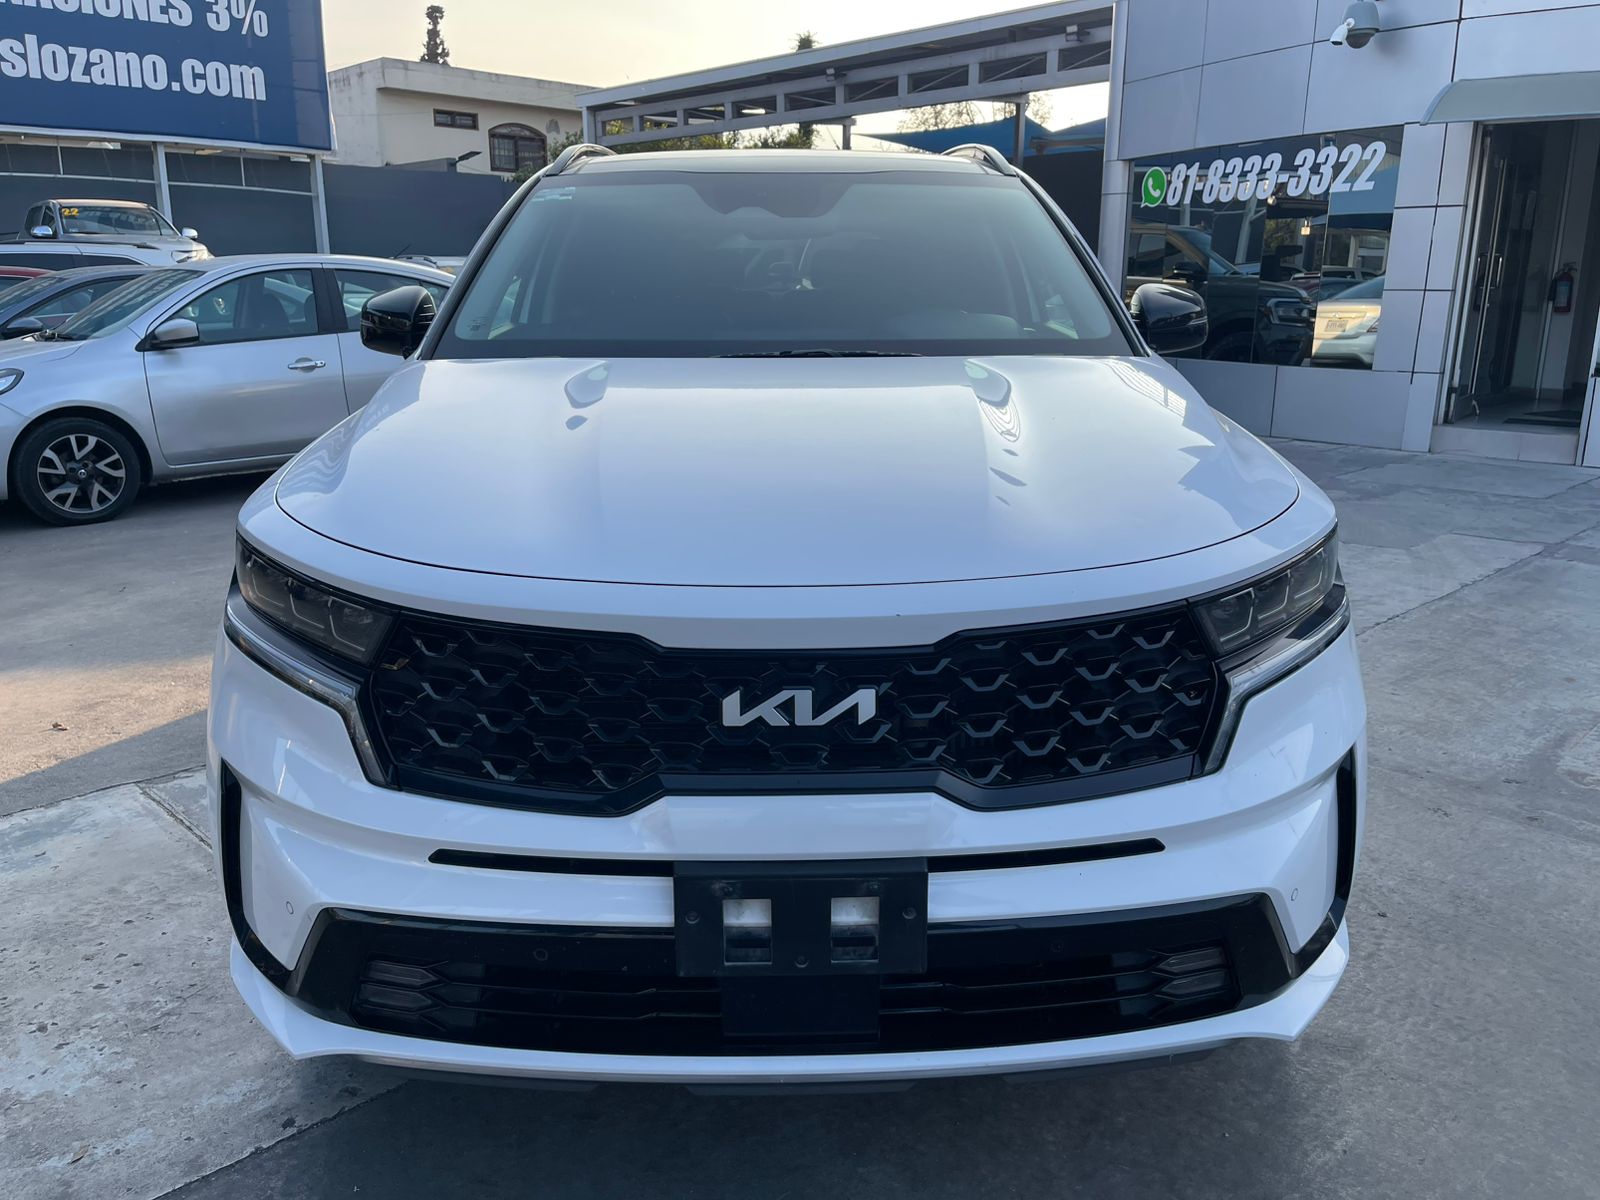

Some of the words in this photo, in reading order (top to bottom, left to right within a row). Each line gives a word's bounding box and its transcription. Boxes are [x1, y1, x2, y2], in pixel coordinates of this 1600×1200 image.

[0, 34, 266, 101] slozano.com
[1166, 141, 1386, 206] 81-8333-3322
[722, 688, 876, 727] KIA
